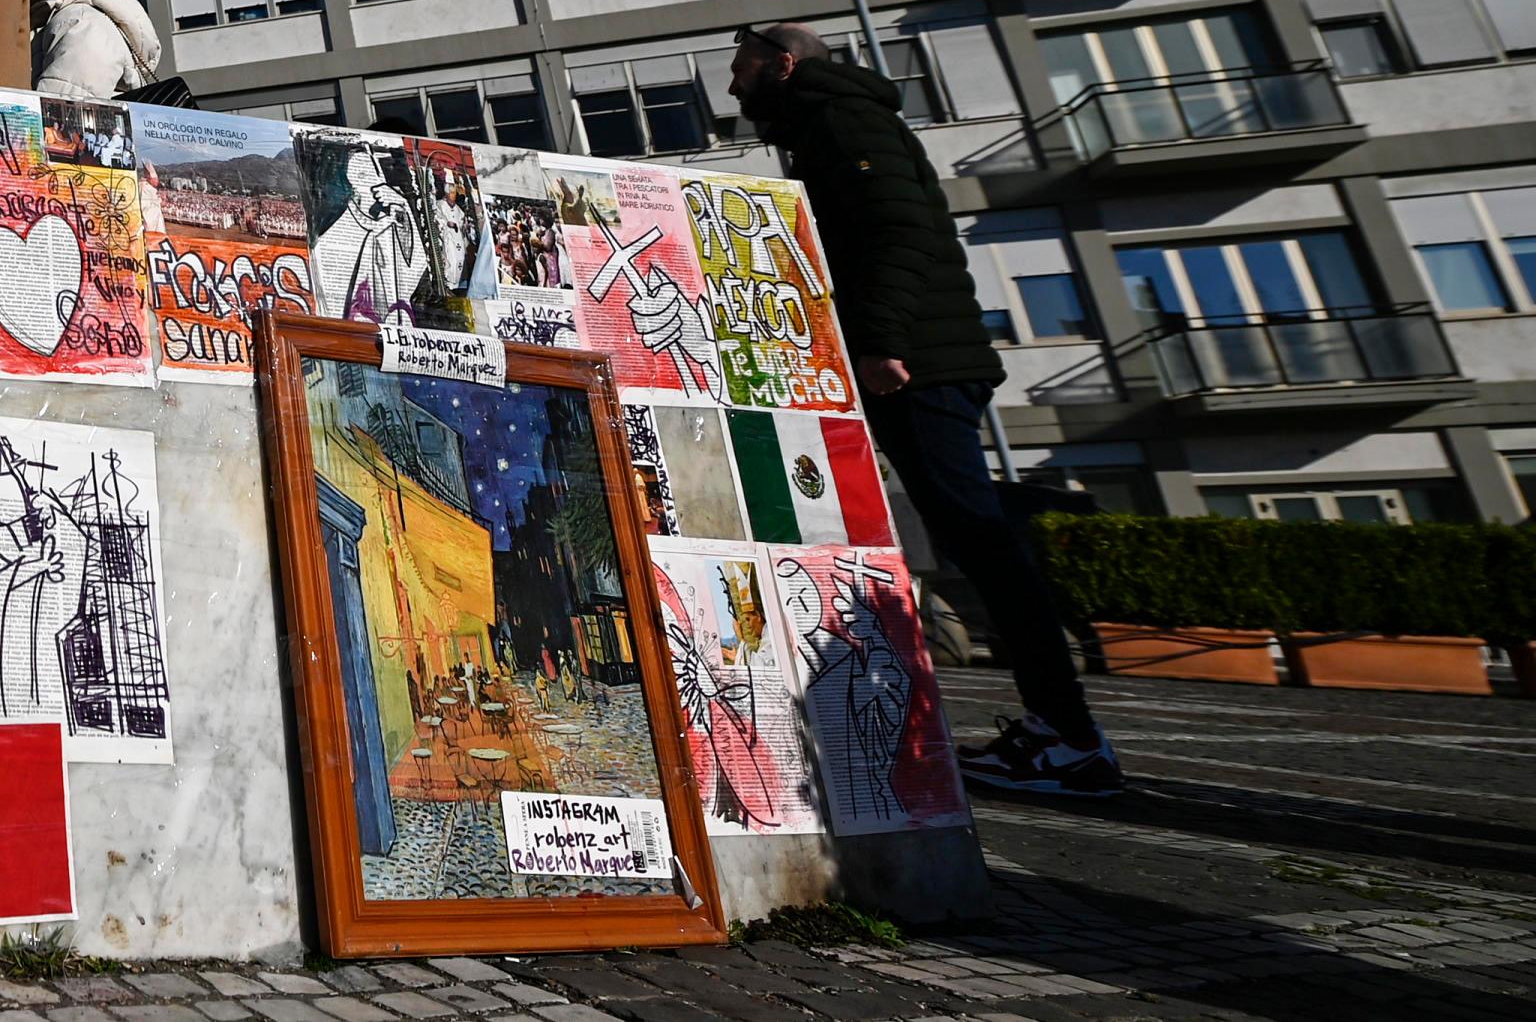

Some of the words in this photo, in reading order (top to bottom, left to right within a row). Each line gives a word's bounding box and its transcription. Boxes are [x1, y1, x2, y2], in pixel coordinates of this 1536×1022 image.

[144, 119, 156, 128] UN
[157, 121, 202, 134] OROLOGIO
[204, 127, 213, 136] IN
[214, 128, 247, 140] REGALO
[144, 129, 171, 140] NELLA
[198, 136, 207, 144] DI
[208, 137, 243, 149] CALVINO
[612, 173, 627, 181] UNA
[627, 175, 653, 183] SERATA
[633, 184, 669, 194] PESCATORI
[619, 200, 639, 208] MARE
[640, 202, 674, 211] ADRIATICO
[681, 180, 825, 300] PAPA
[398, 350, 444, 370] Roberto
[747, 368, 848, 408] MUCHO
[527, 798, 621, 825] INSTAGRAM
[534, 823, 632, 852] robenz_art
[511, 846, 577, 873] Roberto
[579, 849, 647, 878] Marque
